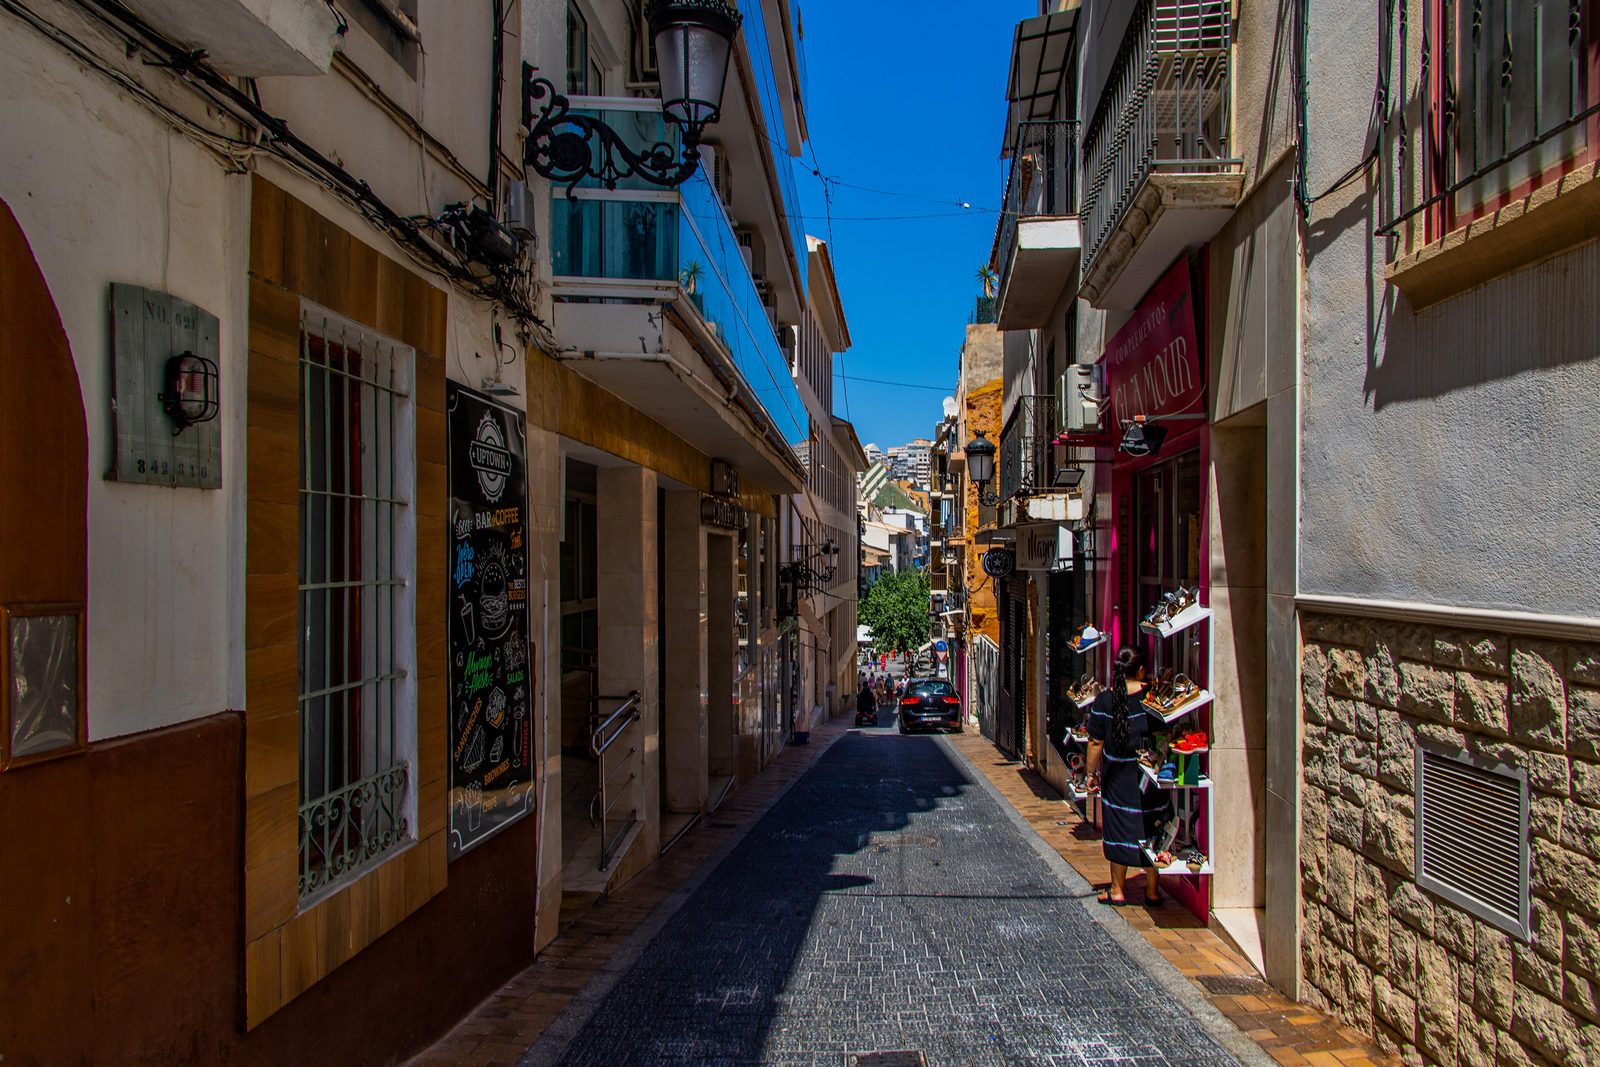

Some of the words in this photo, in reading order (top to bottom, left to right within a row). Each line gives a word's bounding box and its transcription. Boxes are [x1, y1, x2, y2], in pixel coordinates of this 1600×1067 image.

[1114, 301, 1167, 366] COMPLEMENTOS
[1114, 335, 1193, 430] GLAMOUR
[476, 447, 506, 470] UPTOWN
[454, 696, 483, 761] SANDWICHES
[483, 758, 511, 786] BROWNIES
[482, 795, 498, 813] CHIPS
